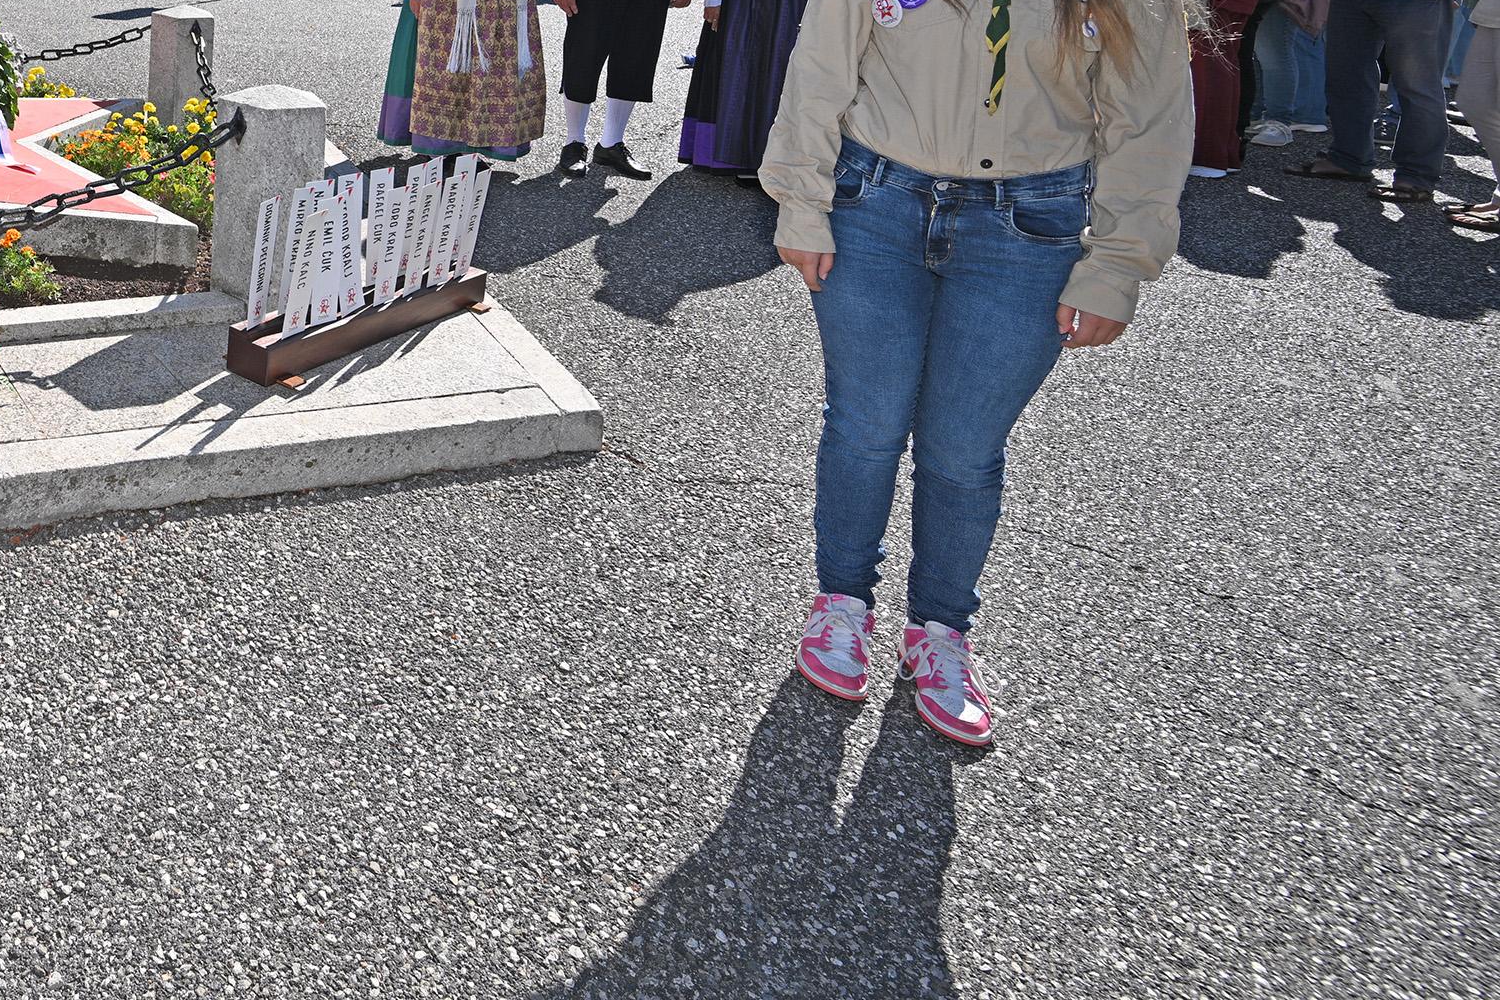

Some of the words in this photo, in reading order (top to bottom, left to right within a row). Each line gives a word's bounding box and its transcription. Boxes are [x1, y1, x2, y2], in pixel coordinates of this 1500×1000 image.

[375, 183, 385, 219] RAFAEL
[410, 177, 420, 204] PAVEL
[262, 203, 275, 244] DOMINIK
[295, 199, 307, 234] MIRKO
[390, 202, 401, 227] ZORO
[405, 208, 415, 238] KRALJ
[304, 230, 317, 258] NINO
[323, 221, 335, 246] EMIL
[385, 232, 397, 263] KRALJ
[414, 228, 426, 259] KRALJ
[438, 224, 451, 254] KRALJ
[297, 262, 311, 290] KALC
[342, 244, 354, 279] KRALJ
